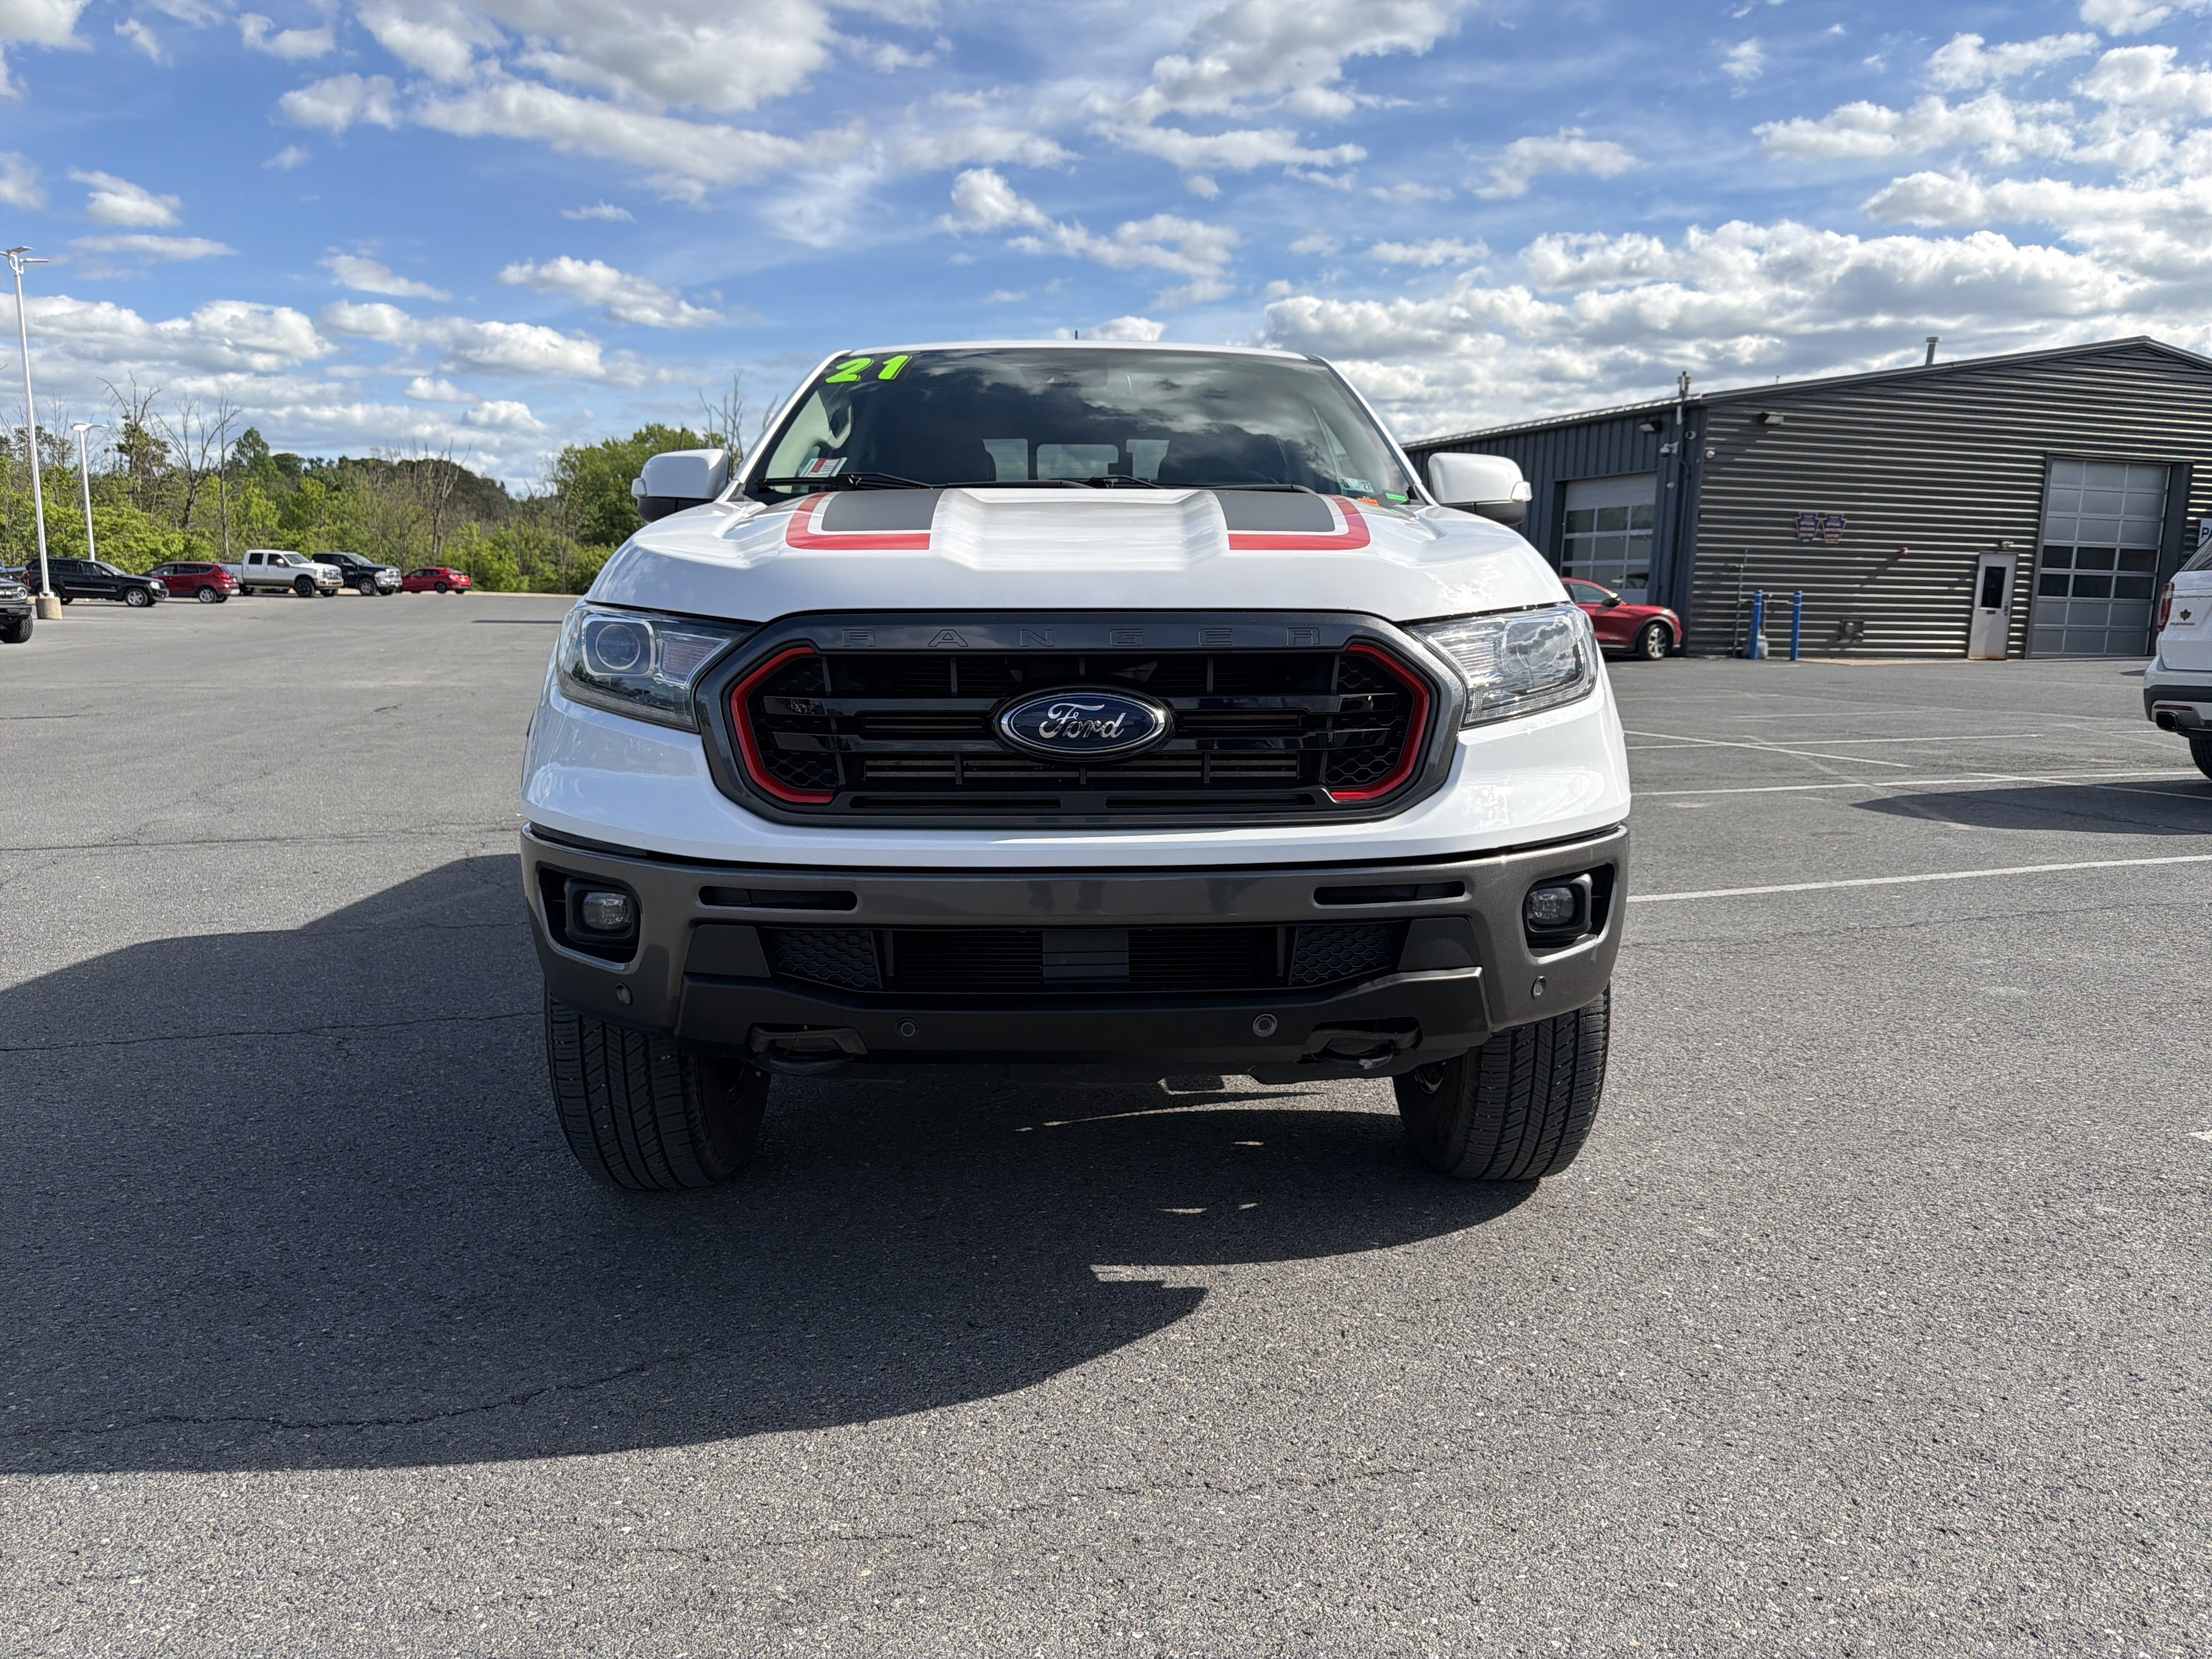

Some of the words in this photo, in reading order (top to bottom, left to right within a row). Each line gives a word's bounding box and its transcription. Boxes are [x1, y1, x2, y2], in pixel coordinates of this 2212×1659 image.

[825, 356, 912, 383] 21
[842, 627, 1321, 647] RANGER
[1039, 703, 1127, 738] Ford
